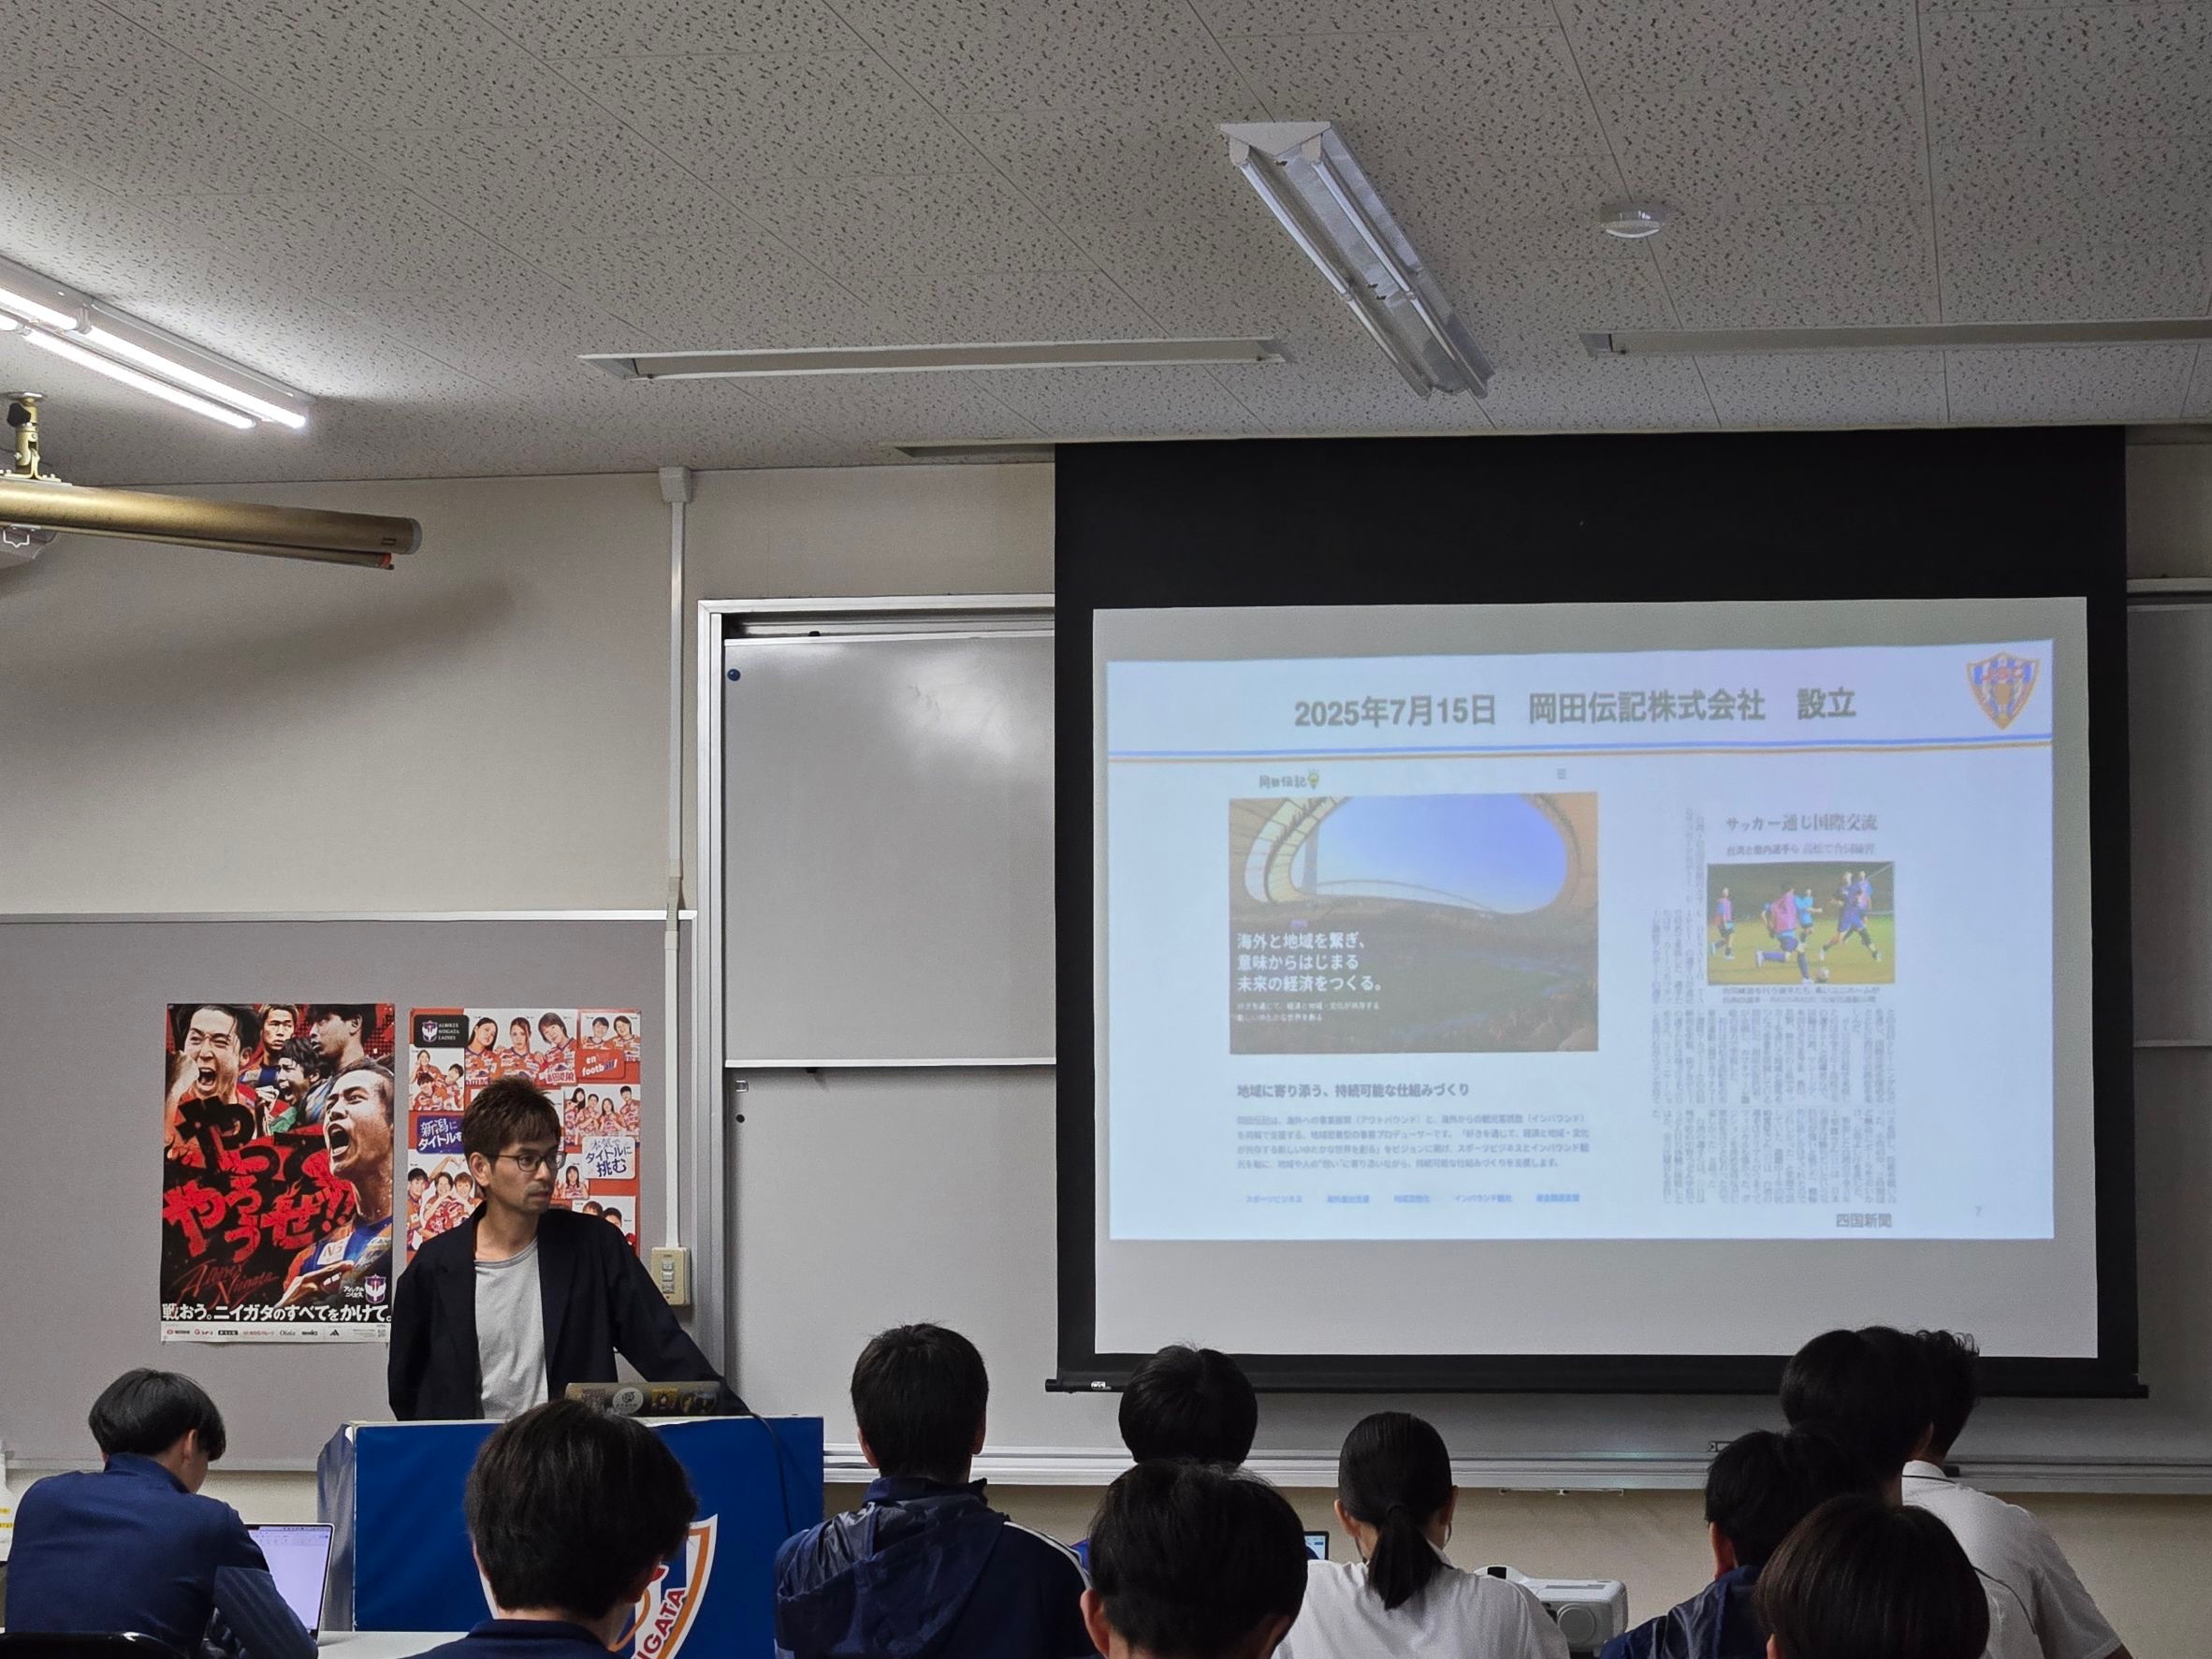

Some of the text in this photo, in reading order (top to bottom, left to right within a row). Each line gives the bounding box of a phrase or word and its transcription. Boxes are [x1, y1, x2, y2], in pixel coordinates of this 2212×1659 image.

[1295, 685, 1856, 727] 2025年7月15日 岡田伝記株式会社 設立
[1725, 812, 1878, 832] サッカー通じ国際交流
[1237, 932, 1365, 950] 海外と地域を繋ぎ、
[1237, 953, 1359, 971] 意味からはじまる
[1237, 974, 1382, 993] 未来の経済をつくる。
[586, 1055, 597, 1065] en
[1237, 1083, 1470, 1099] 地域に寄り添う、持続可能な仕組みづくり
[420, 1117, 458, 1137] 新潟に
[586, 1147, 633, 1164] タイトルに
[596, 1158, 627, 1177] 挑む
[1836, 1213, 1893, 1229] 四国新聞
[162, 1302, 392, 1322] 戦おう。ニイガタのすべてをかけて。
